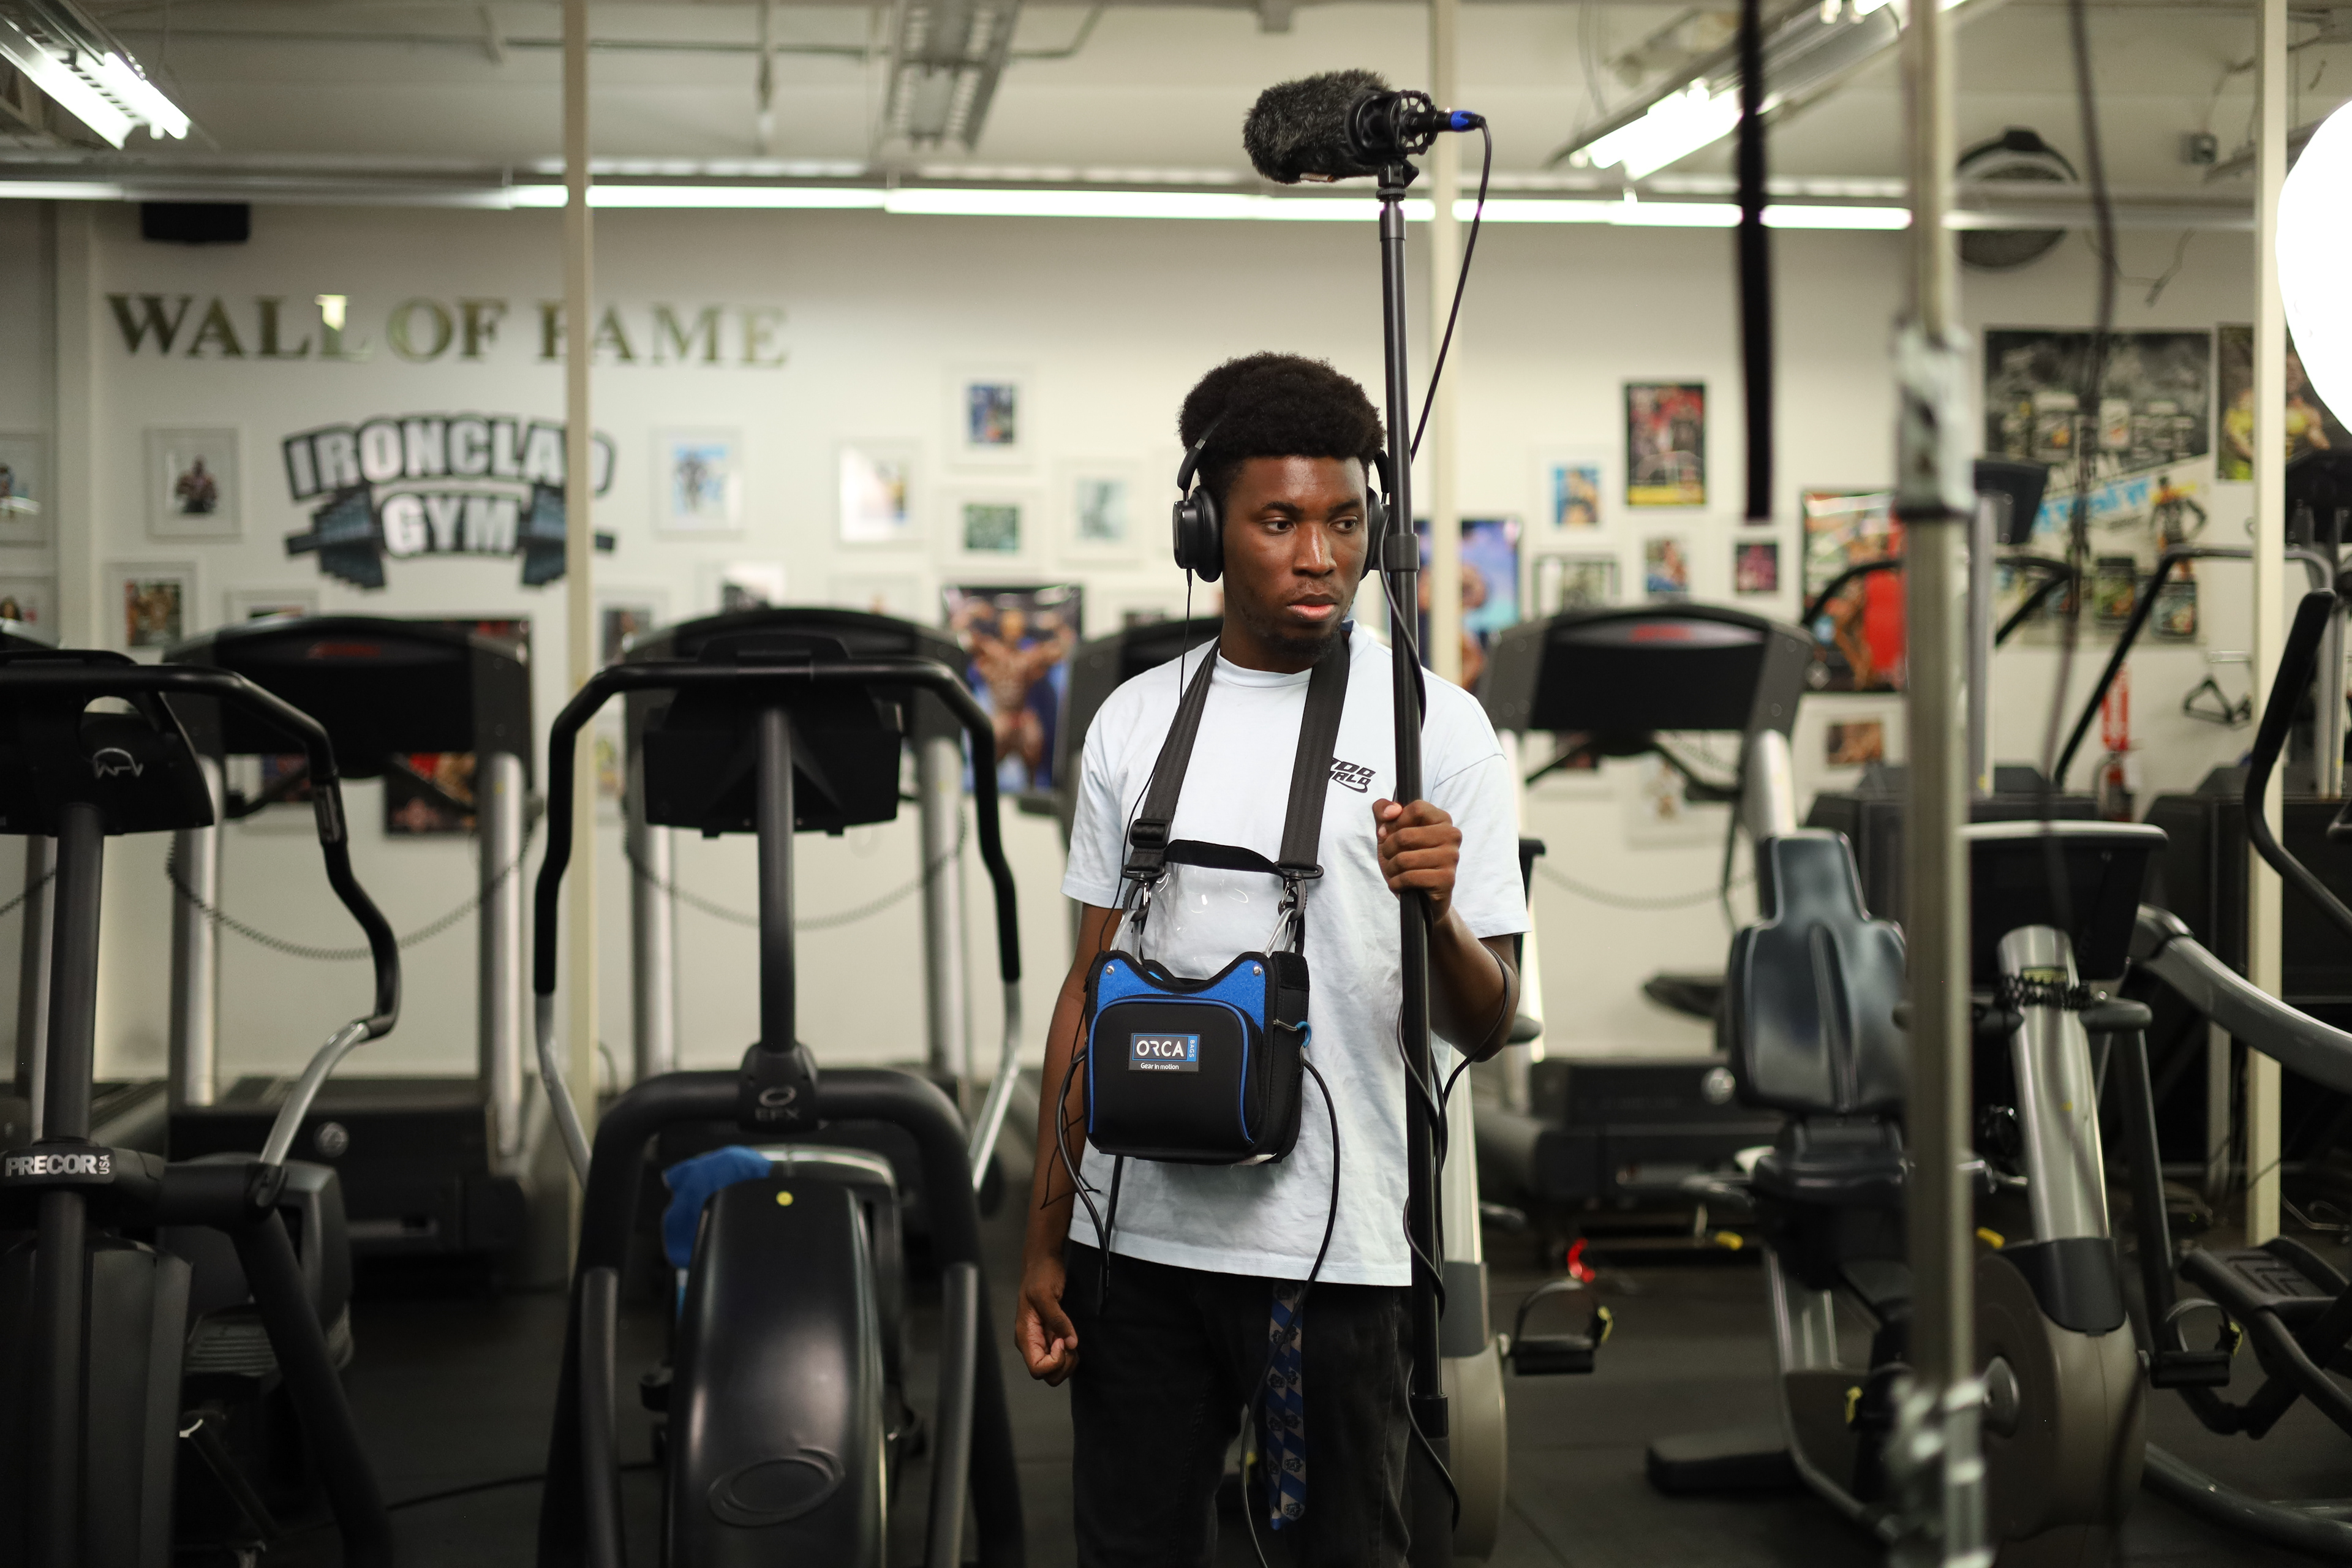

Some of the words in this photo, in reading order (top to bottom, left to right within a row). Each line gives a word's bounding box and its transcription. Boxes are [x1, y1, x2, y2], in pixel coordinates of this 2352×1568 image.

[108, 294, 371, 361] WALL
[387, 295, 509, 361] OF
[380, 491, 521, 559] GYM
[1136, 1040, 1185, 1057] ORCA
[5, 1154, 97, 1177] PRECOR
[99, 1154, 110, 1175] USA
